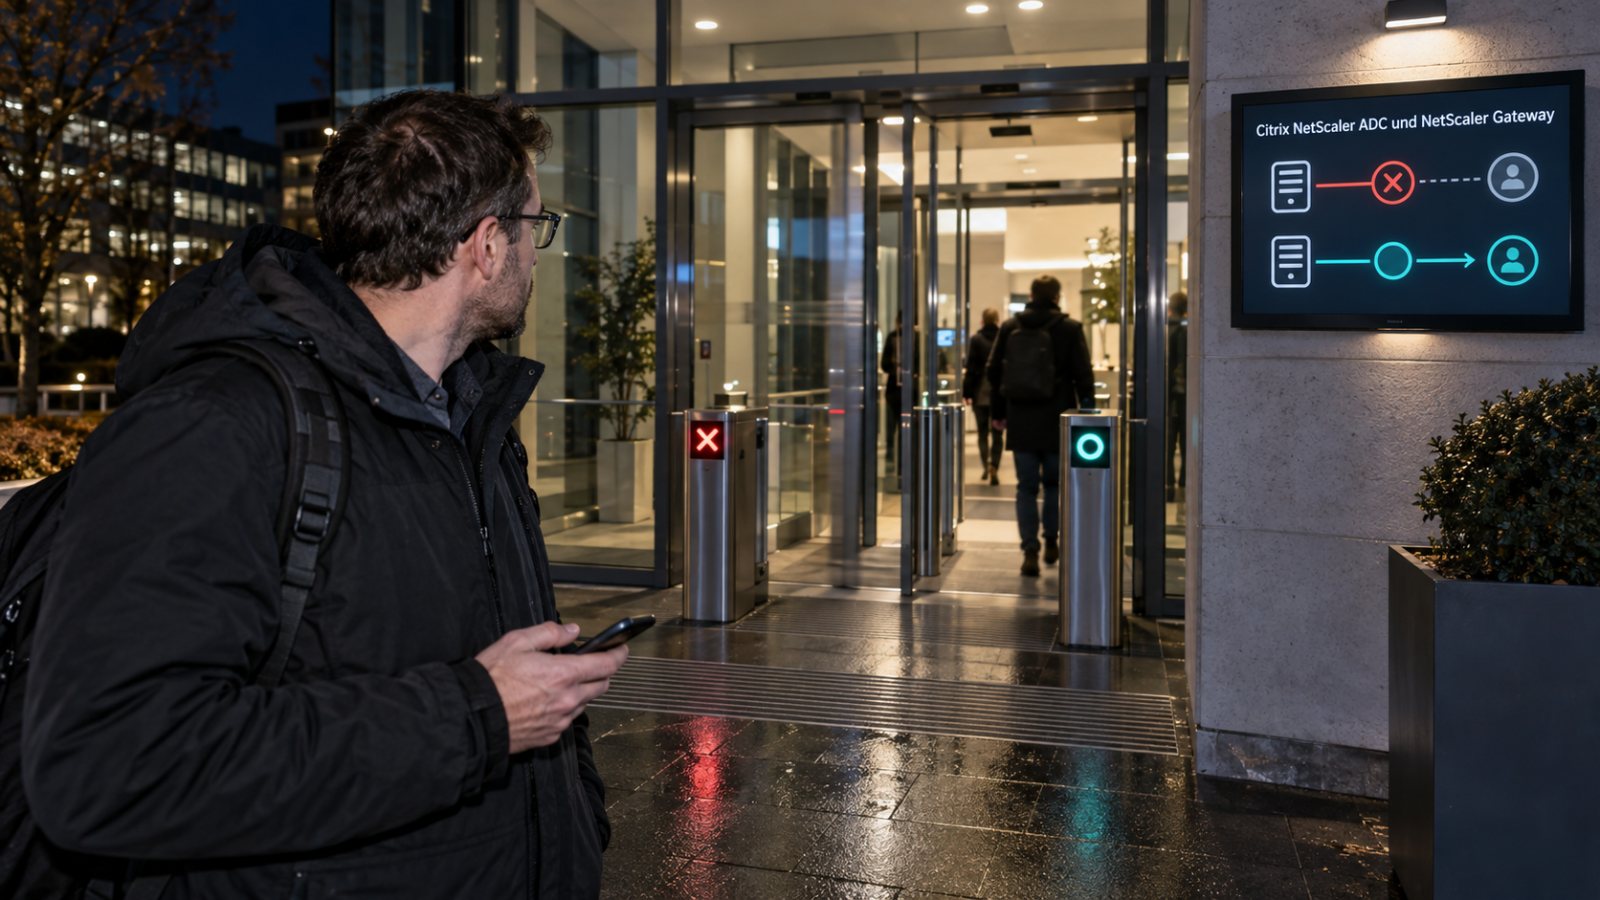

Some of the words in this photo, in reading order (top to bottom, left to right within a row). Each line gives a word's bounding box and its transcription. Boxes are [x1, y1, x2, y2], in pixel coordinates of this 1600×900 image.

[1256, 123, 1290, 137] Citrix
[1293, 119, 1356, 135] NetScaler
[1359, 116, 1388, 131] ADC
[1391, 114, 1417, 130] und
[1421, 112, 1489, 128] NetScaler
[1492, 109, 1555, 125] Gateway
